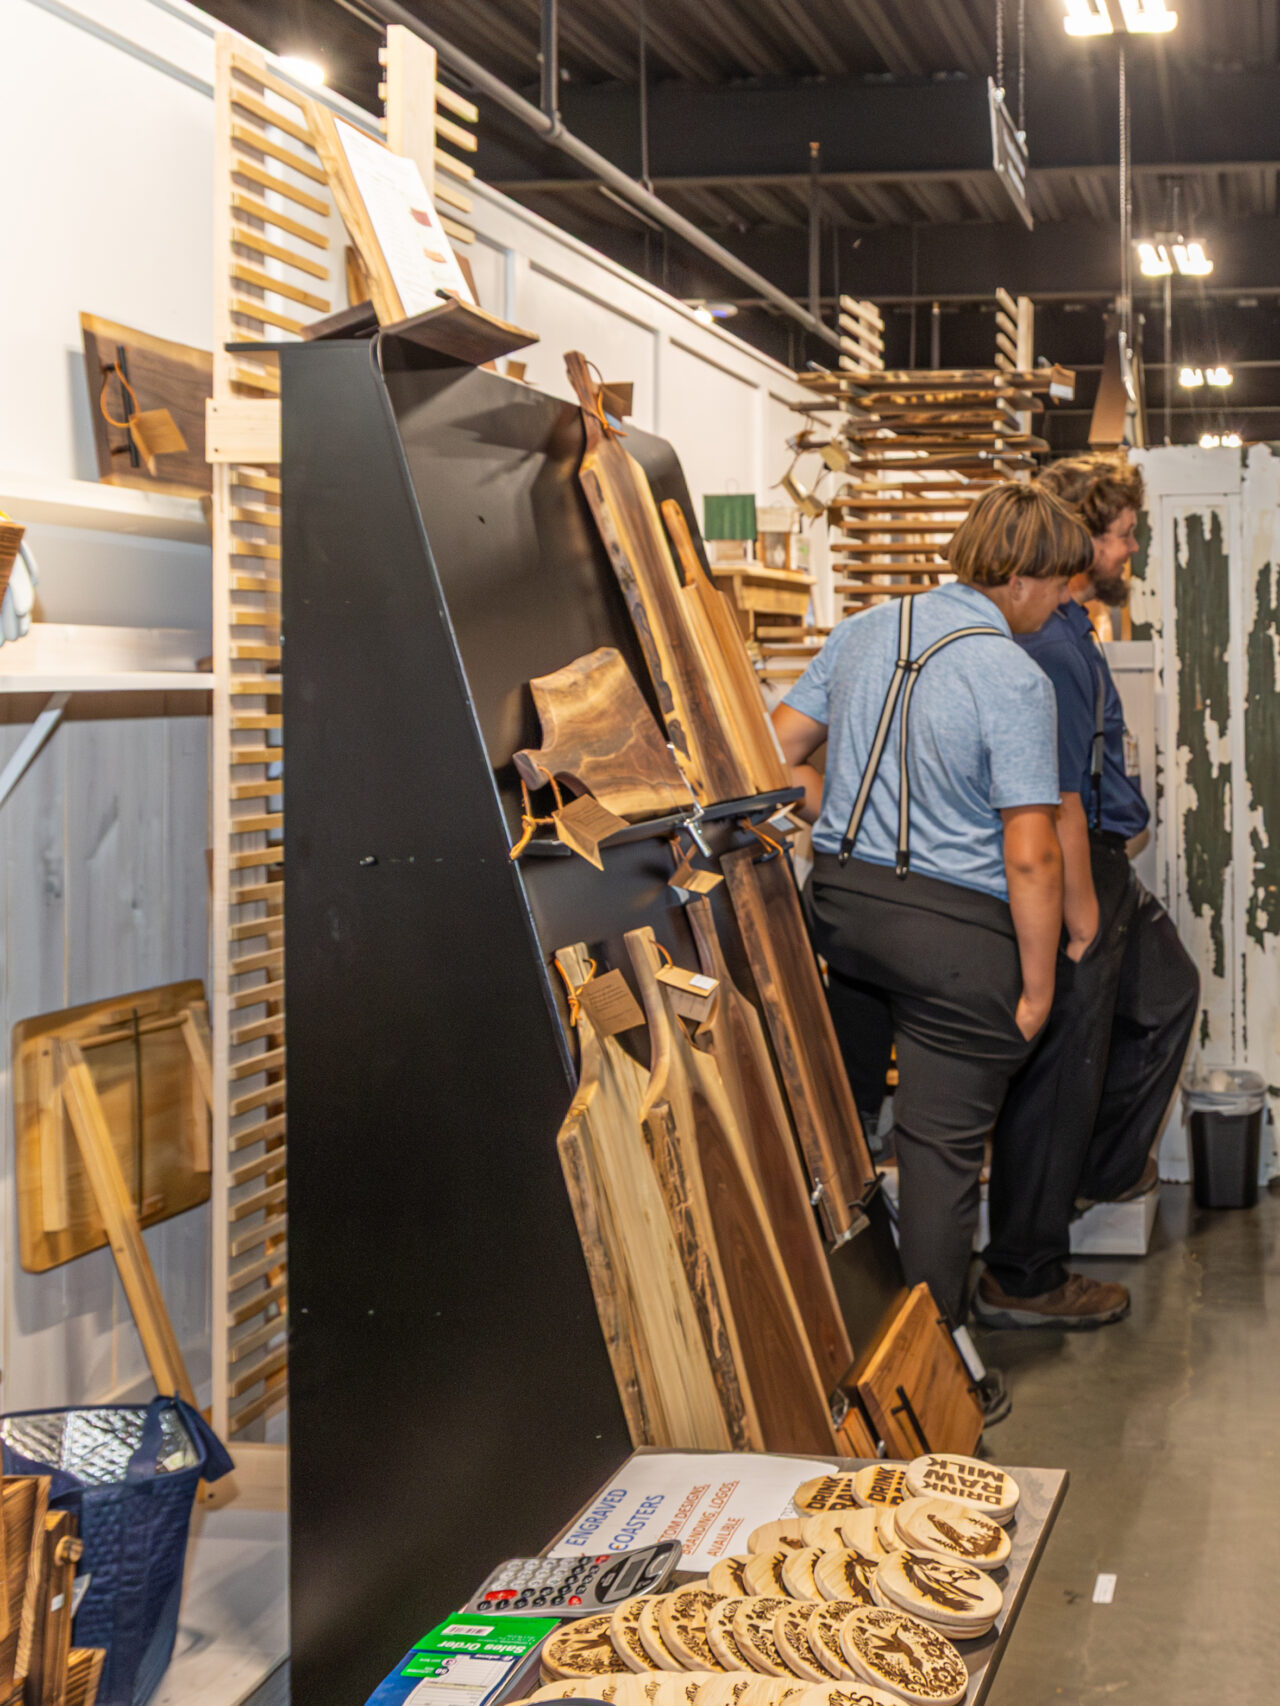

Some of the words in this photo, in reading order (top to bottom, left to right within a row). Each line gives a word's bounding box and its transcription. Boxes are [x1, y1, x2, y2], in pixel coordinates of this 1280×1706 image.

[923, 1468, 1003, 1495] RAW
[926, 1456, 1005, 1483] MILK
[806, 1475, 844, 1510] DRINK
[867, 1466, 897, 1502] DRINK
[921, 1480, 1002, 1506] DRINK
[564, 1488, 628, 1547] ENGRAVED
[607, 1494, 666, 1552] COASTERS
[437, 1640, 481, 1651] Order
[483, 1643, 527, 1653] Sales
